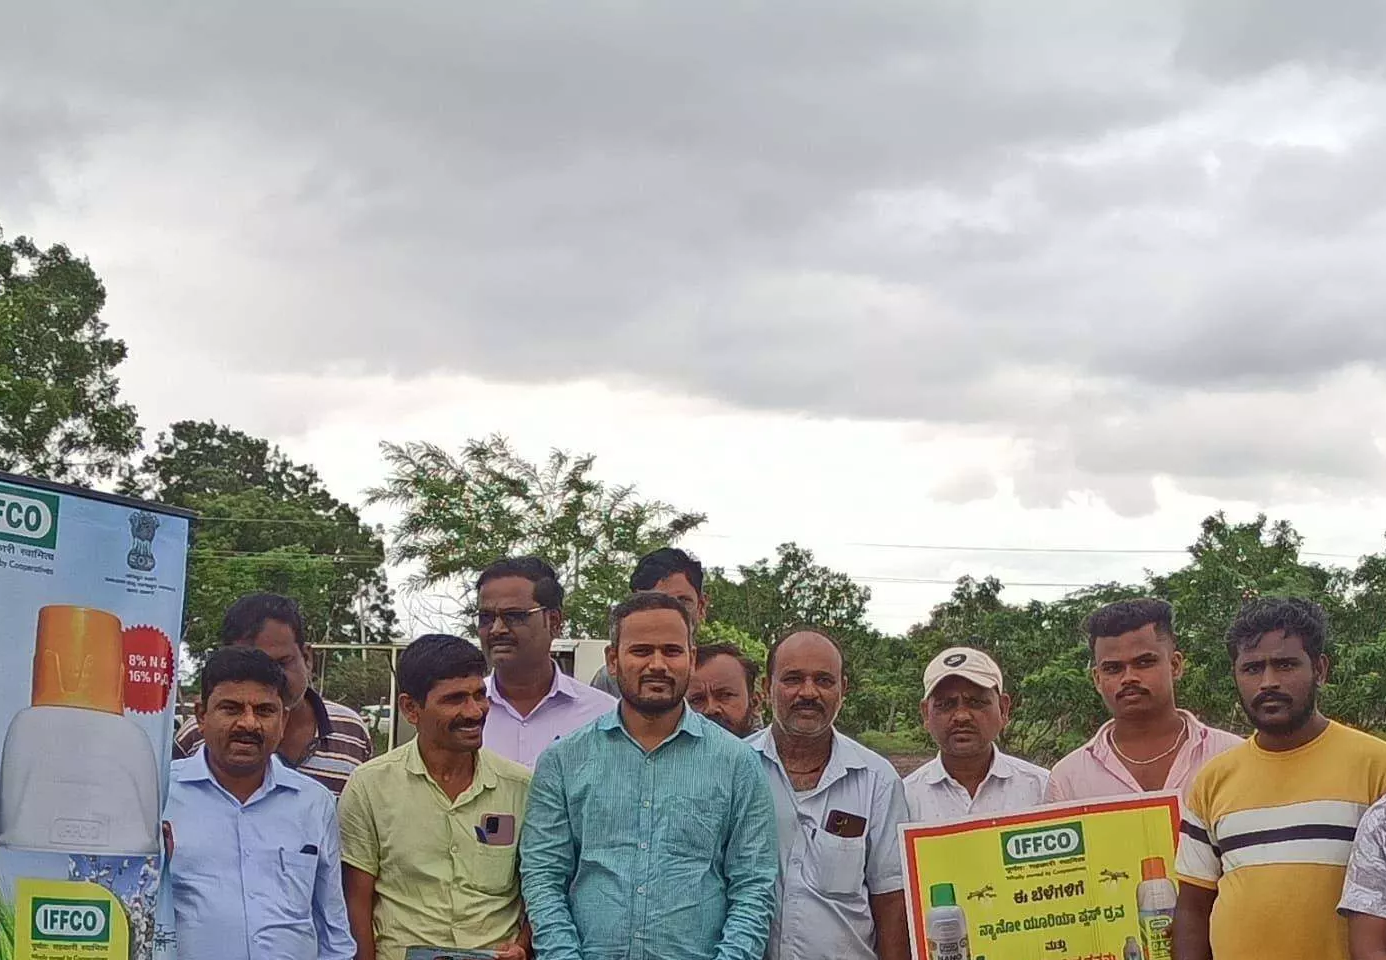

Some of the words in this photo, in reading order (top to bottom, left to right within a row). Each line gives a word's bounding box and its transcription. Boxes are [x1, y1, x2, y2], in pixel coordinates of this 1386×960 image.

[0, 558, 7, 568] by
[129, 654, 146, 667] 8%
[150, 656, 158, 668] N
[160, 657, 167, 669] &
[128, 670, 151, 683] 16%
[1014, 832, 1071, 855] IFFCO
[1014, 889, 1028, 904] ಈ
[1031, 880, 1085, 901] ಬೆಳೆಗಳಿಗೆ
[44, 909, 96, 931] IFFCO
[979, 919, 1021, 940] ನ್ಯಾನೋ
[1024, 911, 1076, 931] ಯೂರಿಯಾ
[1103, 904, 1125, 922] ದ್ರವ
[1045, 939, 1067, 952] ಮತ್ತು
